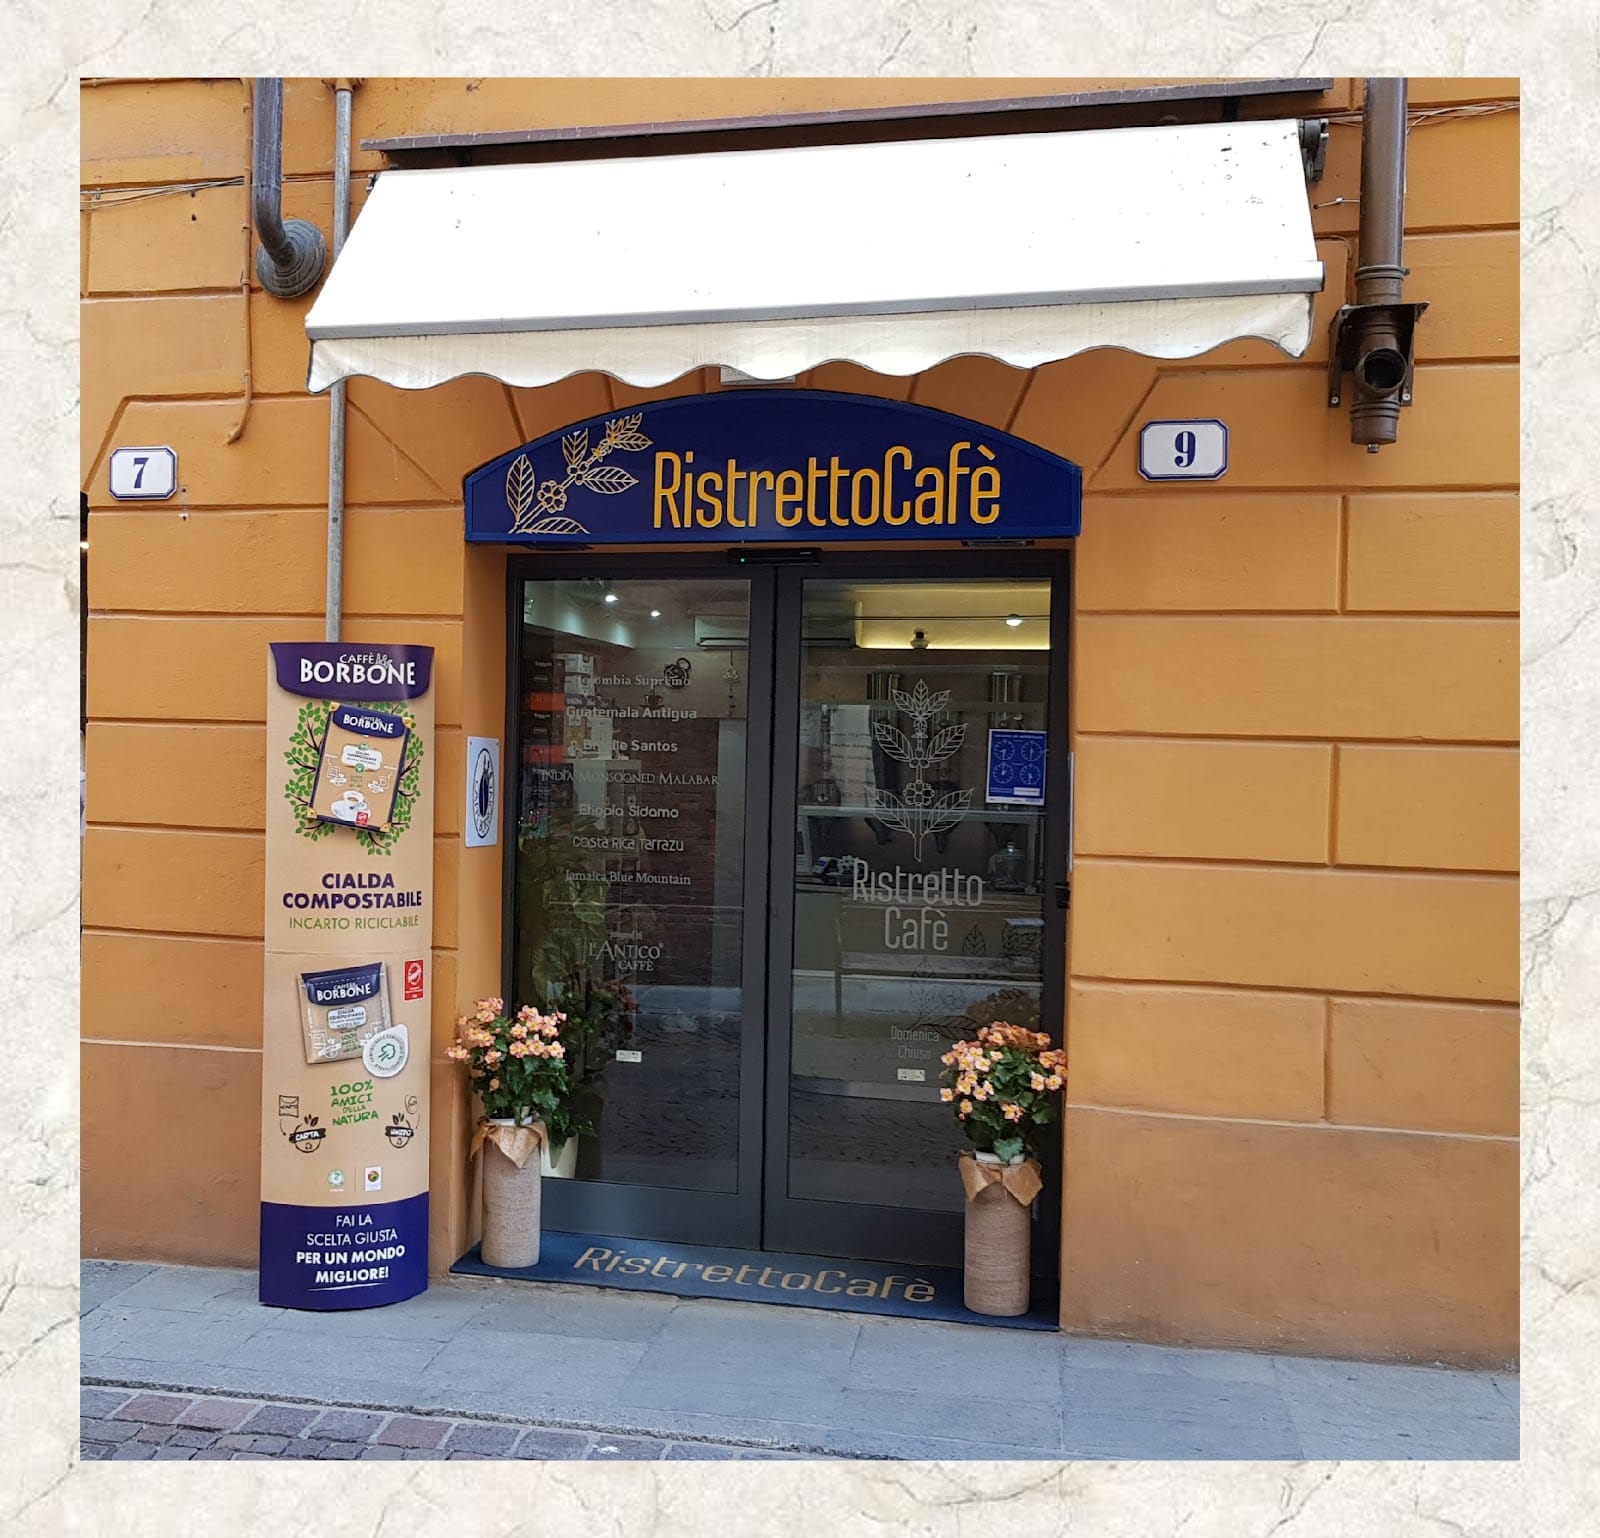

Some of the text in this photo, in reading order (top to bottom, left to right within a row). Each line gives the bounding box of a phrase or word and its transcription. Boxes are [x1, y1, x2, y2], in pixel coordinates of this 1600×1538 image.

[1174, 431, 1196, 468] 9
[133, 457, 149, 489] 7
[653, 441, 1000, 529] RistrettoCafè
[340, 652, 374, 664] CAFFÈ
[301, 658, 416, 686] BORBONE
[634, 675, 691, 690] Supremo
[566, 705, 639, 718] Guatemala
[642, 707, 697, 722] Antigua
[343, 714, 394, 734] BORBONE
[631, 740, 679, 752] Santos
[628, 804, 679, 818] Sidamo
[639, 838, 685, 852] Tarrazu
[322, 872, 395, 889] CIALDA
[565, 869, 691, 885] Jamaica Blue Mountain
[853, 857, 983, 907] Ristretto
[282, 890, 422, 910] COMPOSTABILE
[289, 915, 419, 930] INCARTO RICICLABILE
[884, 906, 948, 951] Cafè
[316, 983, 371, 1001] BORBONE
[890, 1025, 940, 1042] Domenica
[330, 1079, 374, 1096] 100%
[331, 1093, 373, 1108] AMICI
[332, 1110, 379, 1126] NATURA
[342, 1105, 367, 1114] DELLA
[336, 1214, 373, 1227] FAI LA
[306, 1228, 398, 1246] SCELTA GIUSTA
[296, 1245, 405, 1264] PER UN MONDO
[315, 1266, 389, 1283] MIGLIORE!
[572, 1245, 936, 1303] RistrettoCafè
